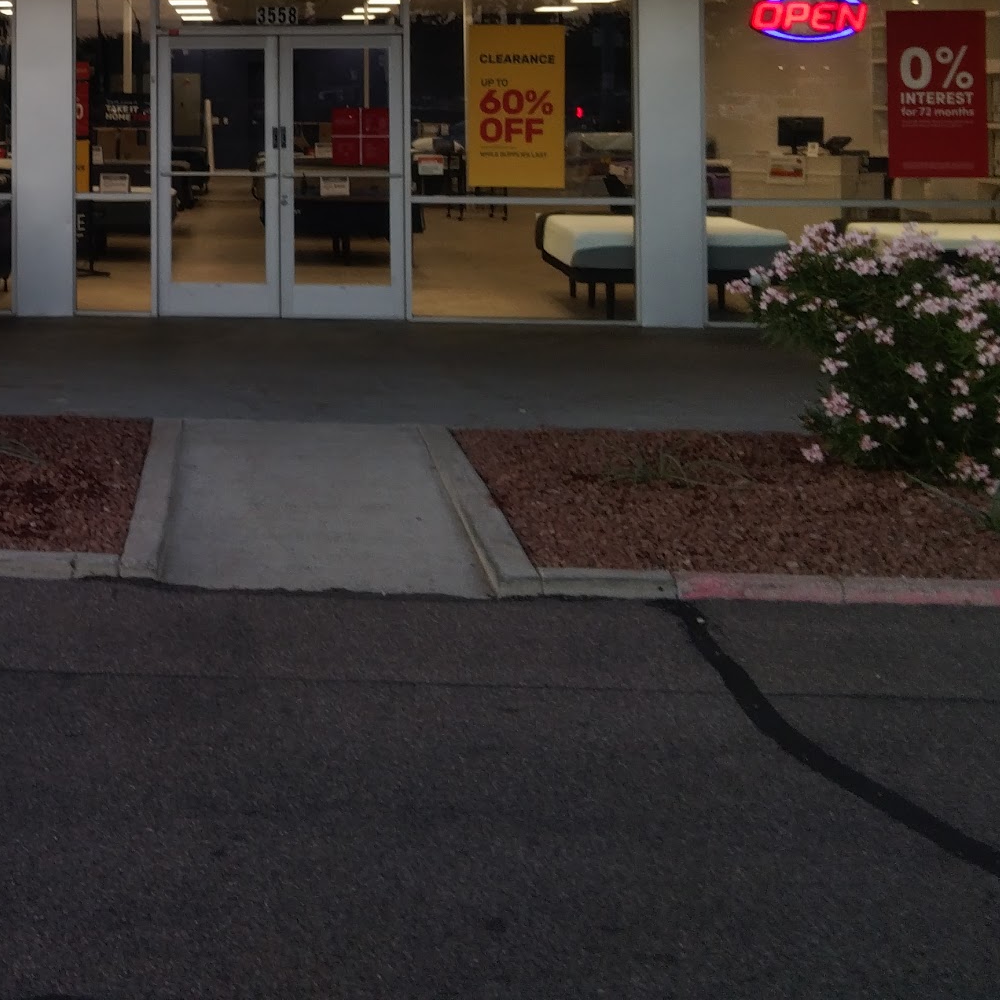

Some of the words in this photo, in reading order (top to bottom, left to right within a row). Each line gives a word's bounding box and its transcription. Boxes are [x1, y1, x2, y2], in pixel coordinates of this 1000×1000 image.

[257, 6, 297, 23] 3558
[751, 1, 868, 32] OPEN
[480, 54, 555, 64] CLEARANCE
[901, 45, 974, 89] 0%
[481, 79, 494, 87] UP
[496, 79, 508, 87] TO
[480, 89, 553, 115] 60%
[900, 92, 974, 105] INTEREST
[901, 107, 917, 117] for
[919, 106, 931, 116] 72
[935, 107, 975, 116] months
[480, 118, 544, 143] OFF
